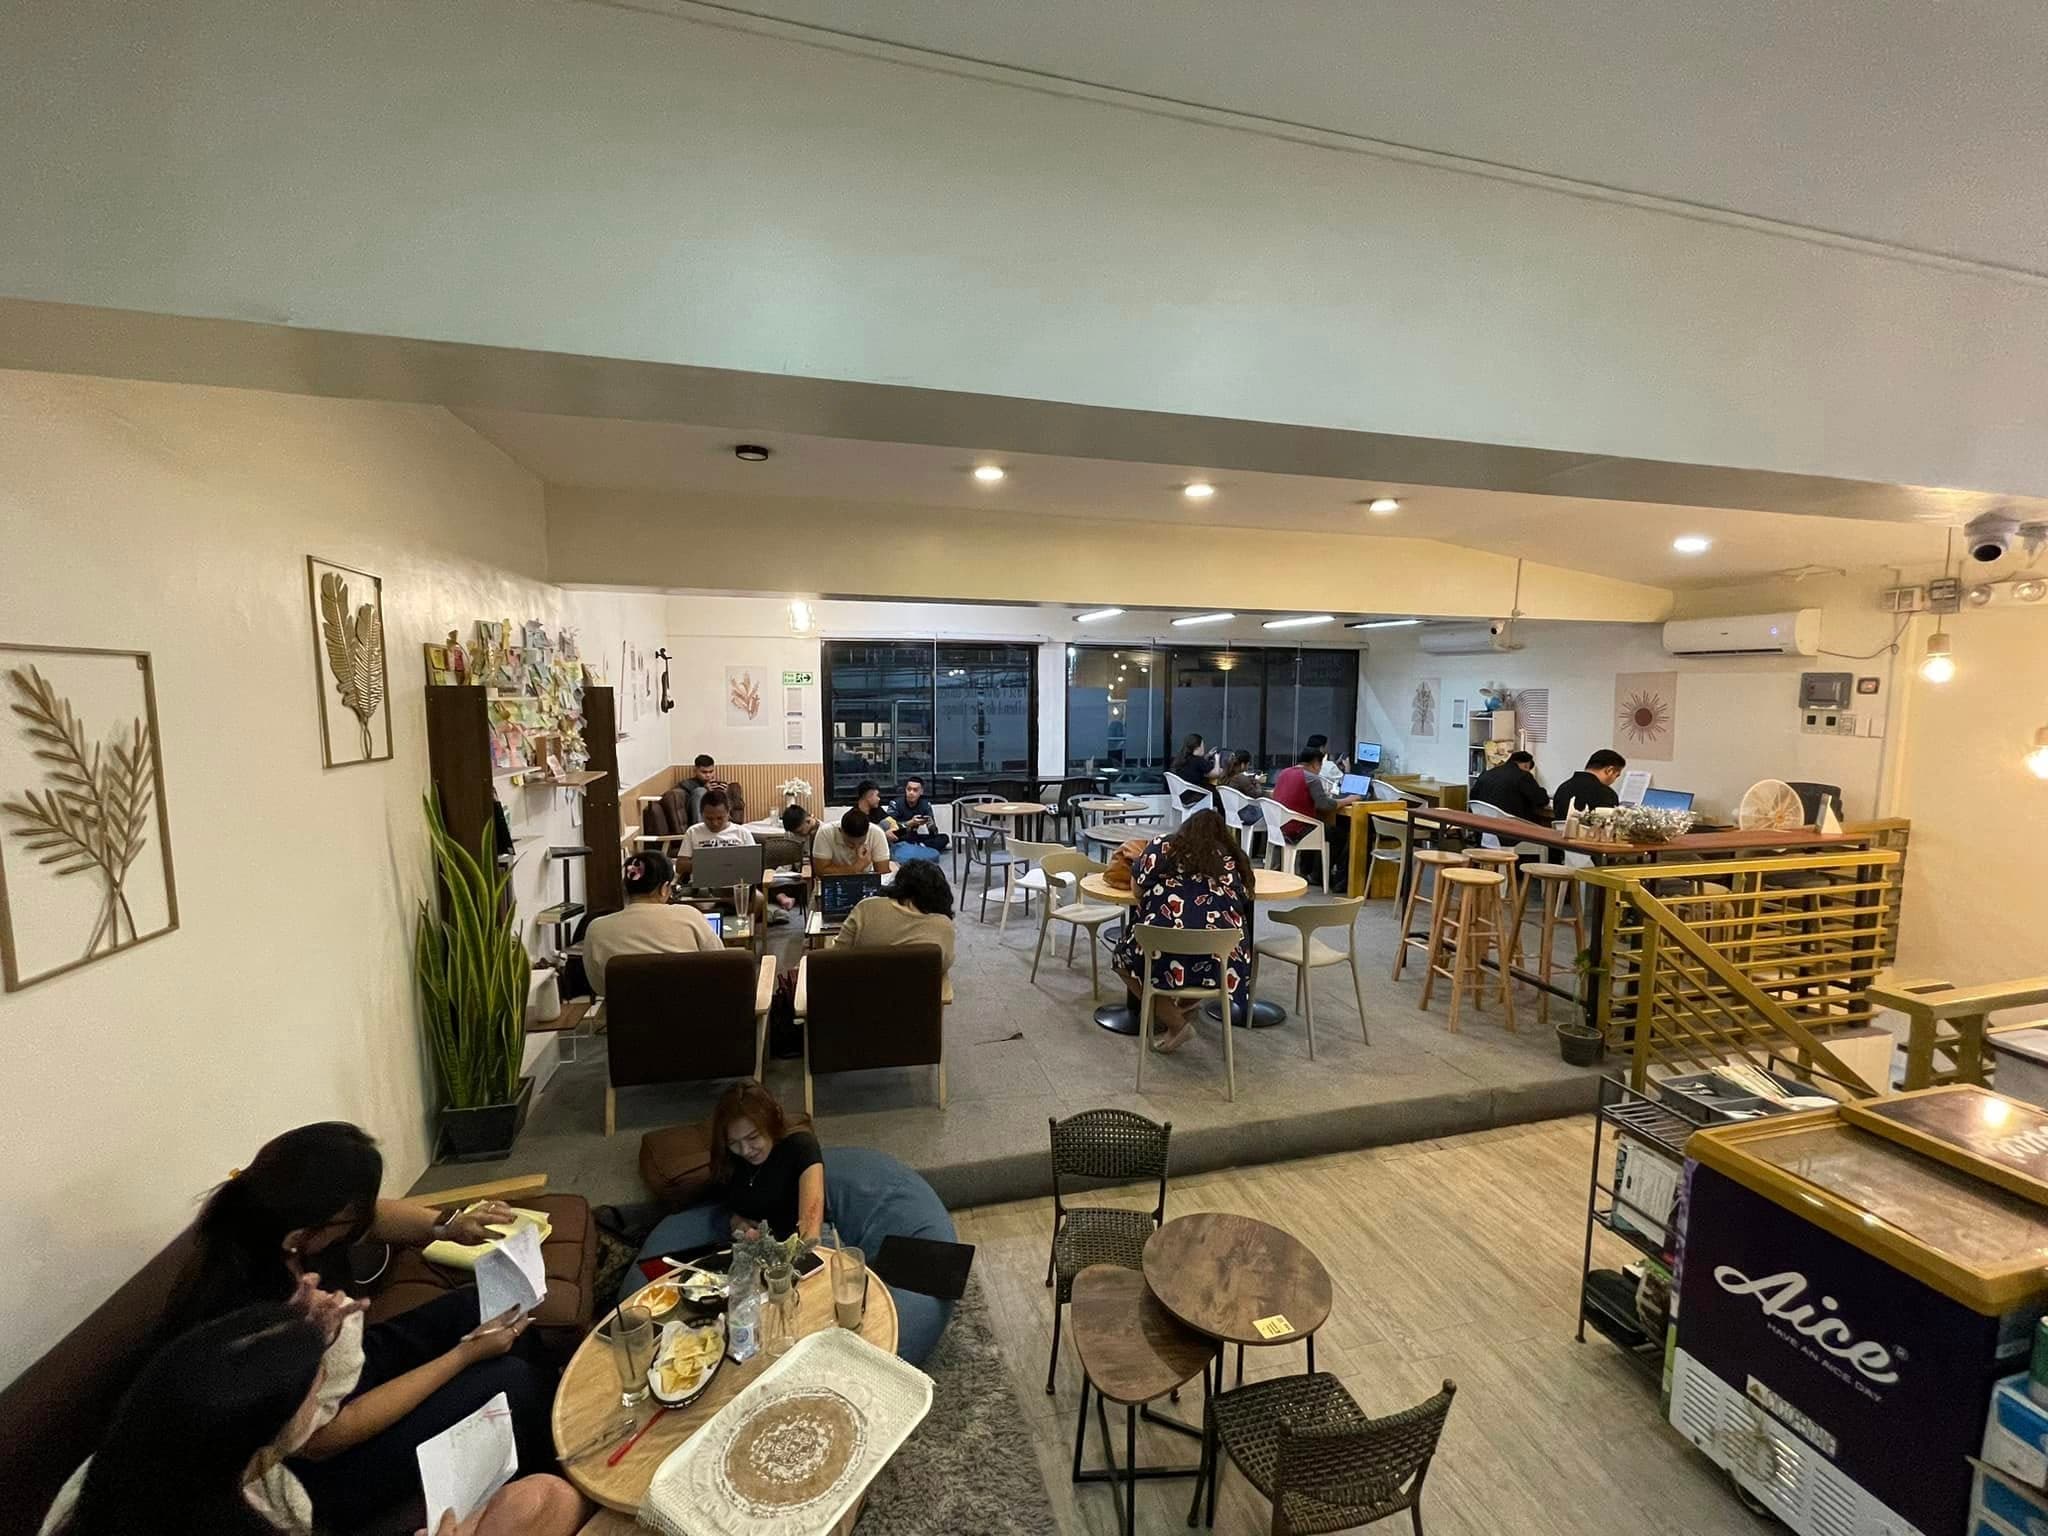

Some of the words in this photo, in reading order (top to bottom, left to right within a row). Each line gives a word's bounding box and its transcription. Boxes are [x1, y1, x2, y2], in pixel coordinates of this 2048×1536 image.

[1714, 1265, 1899, 1383] Aice
[1767, 1322, 1798, 1348] HAVE
[1800, 1346, 1819, 1361] AN
[1855, 1380, 1883, 1402] DAY
